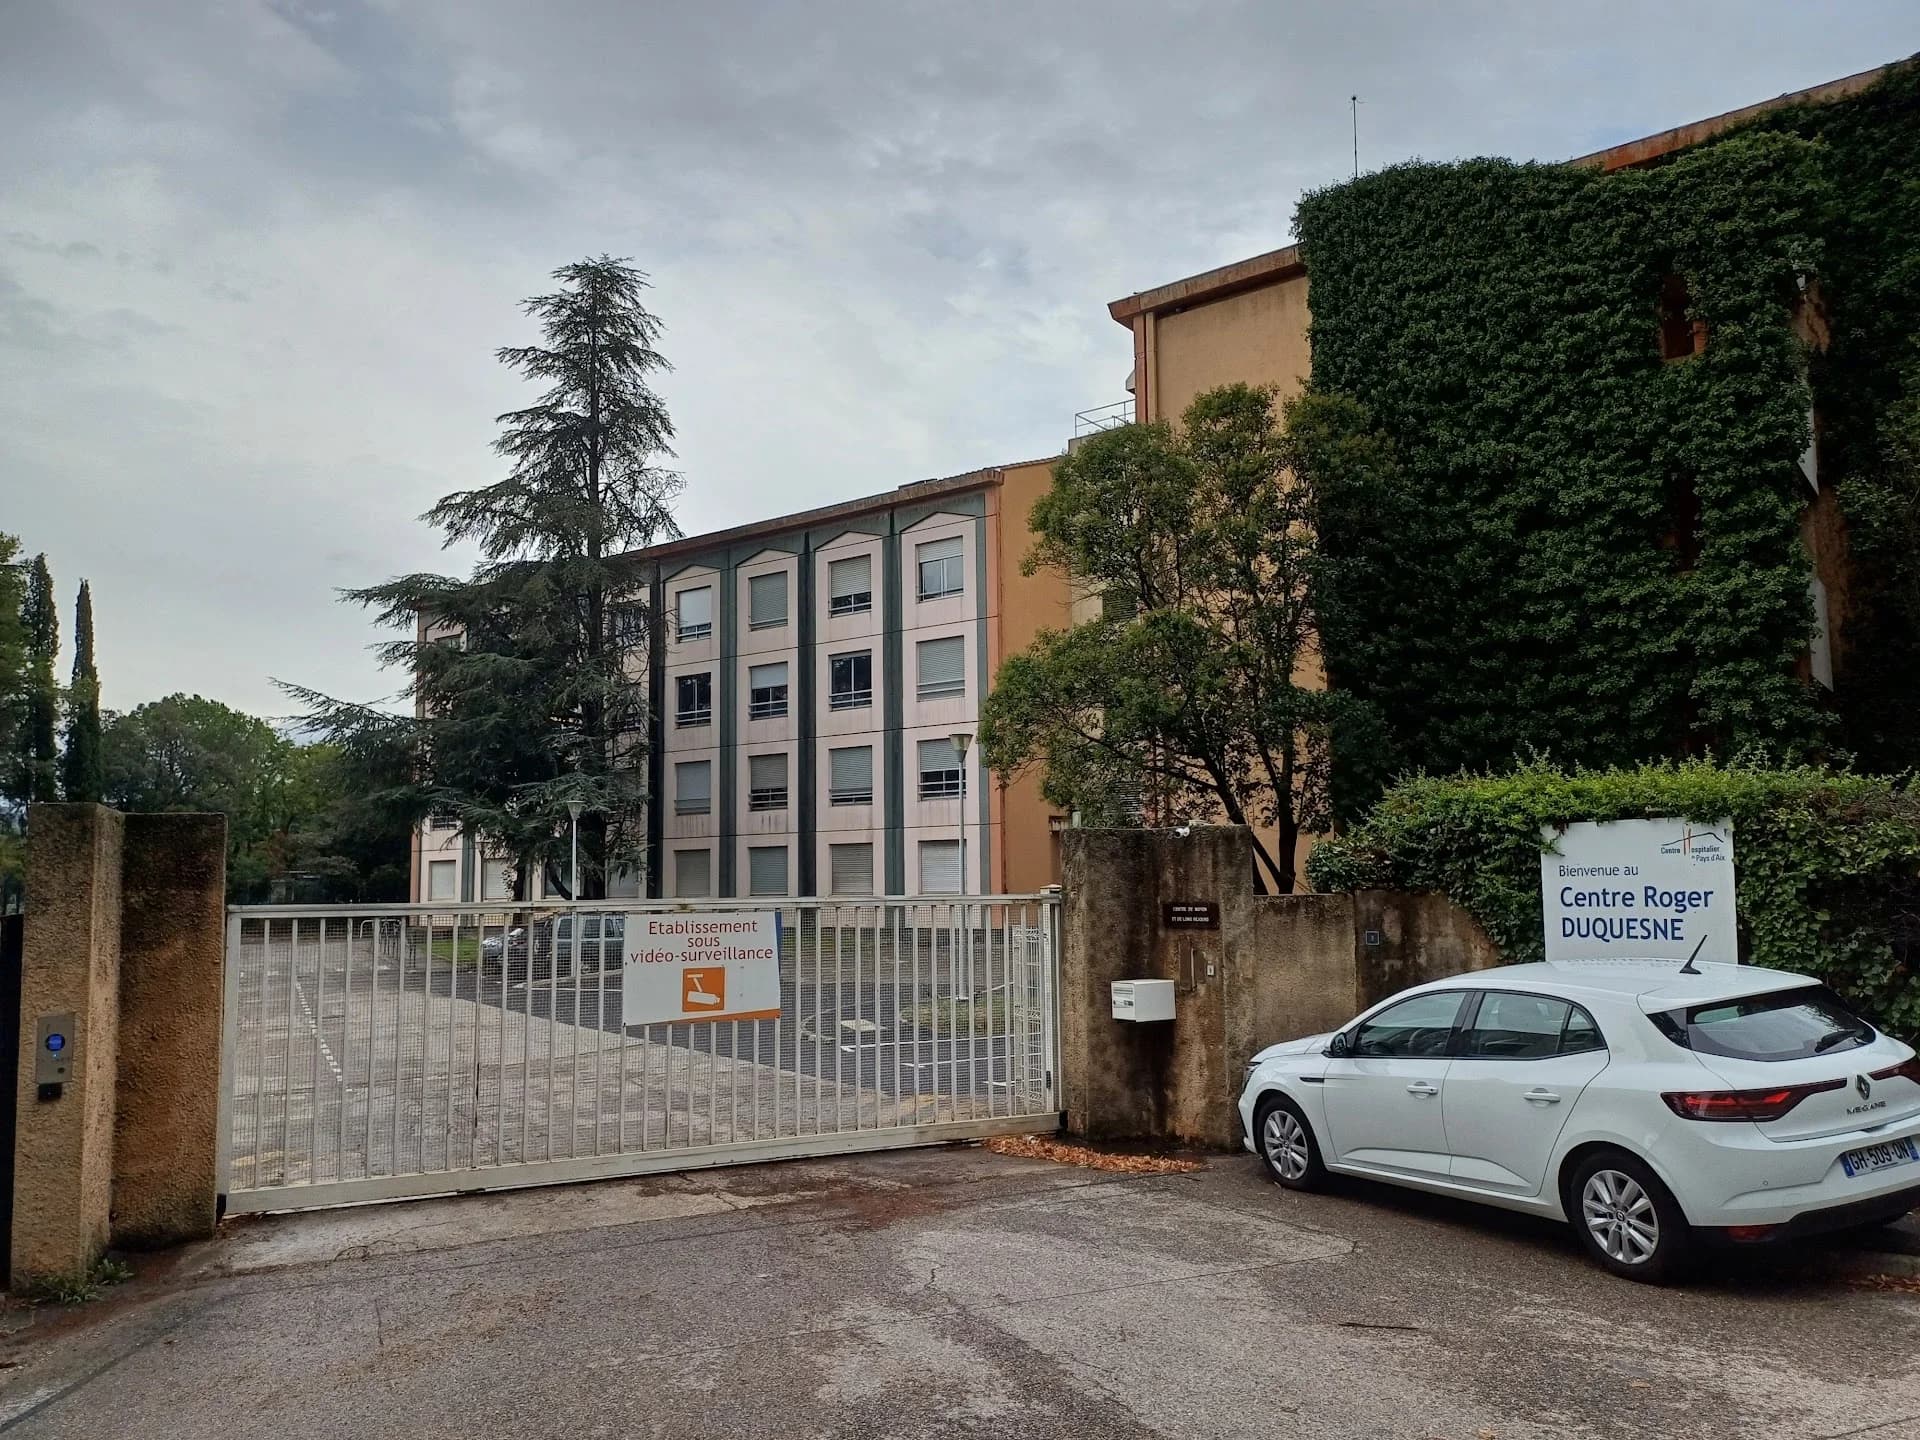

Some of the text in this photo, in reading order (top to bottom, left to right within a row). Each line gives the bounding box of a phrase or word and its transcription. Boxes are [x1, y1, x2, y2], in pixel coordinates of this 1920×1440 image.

[1558, 864, 1639, 877] Bienvenue au
[1560, 885, 1714, 914] Centre Roger
[649, 920, 758, 935] Etablissement
[1562, 917, 1685, 943] DUQUESNE
[687, 936, 720, 948] sous
[630, 946, 774, 964] vidéo-surveillance
[1846, 1100, 1887, 1115] MEGANE
